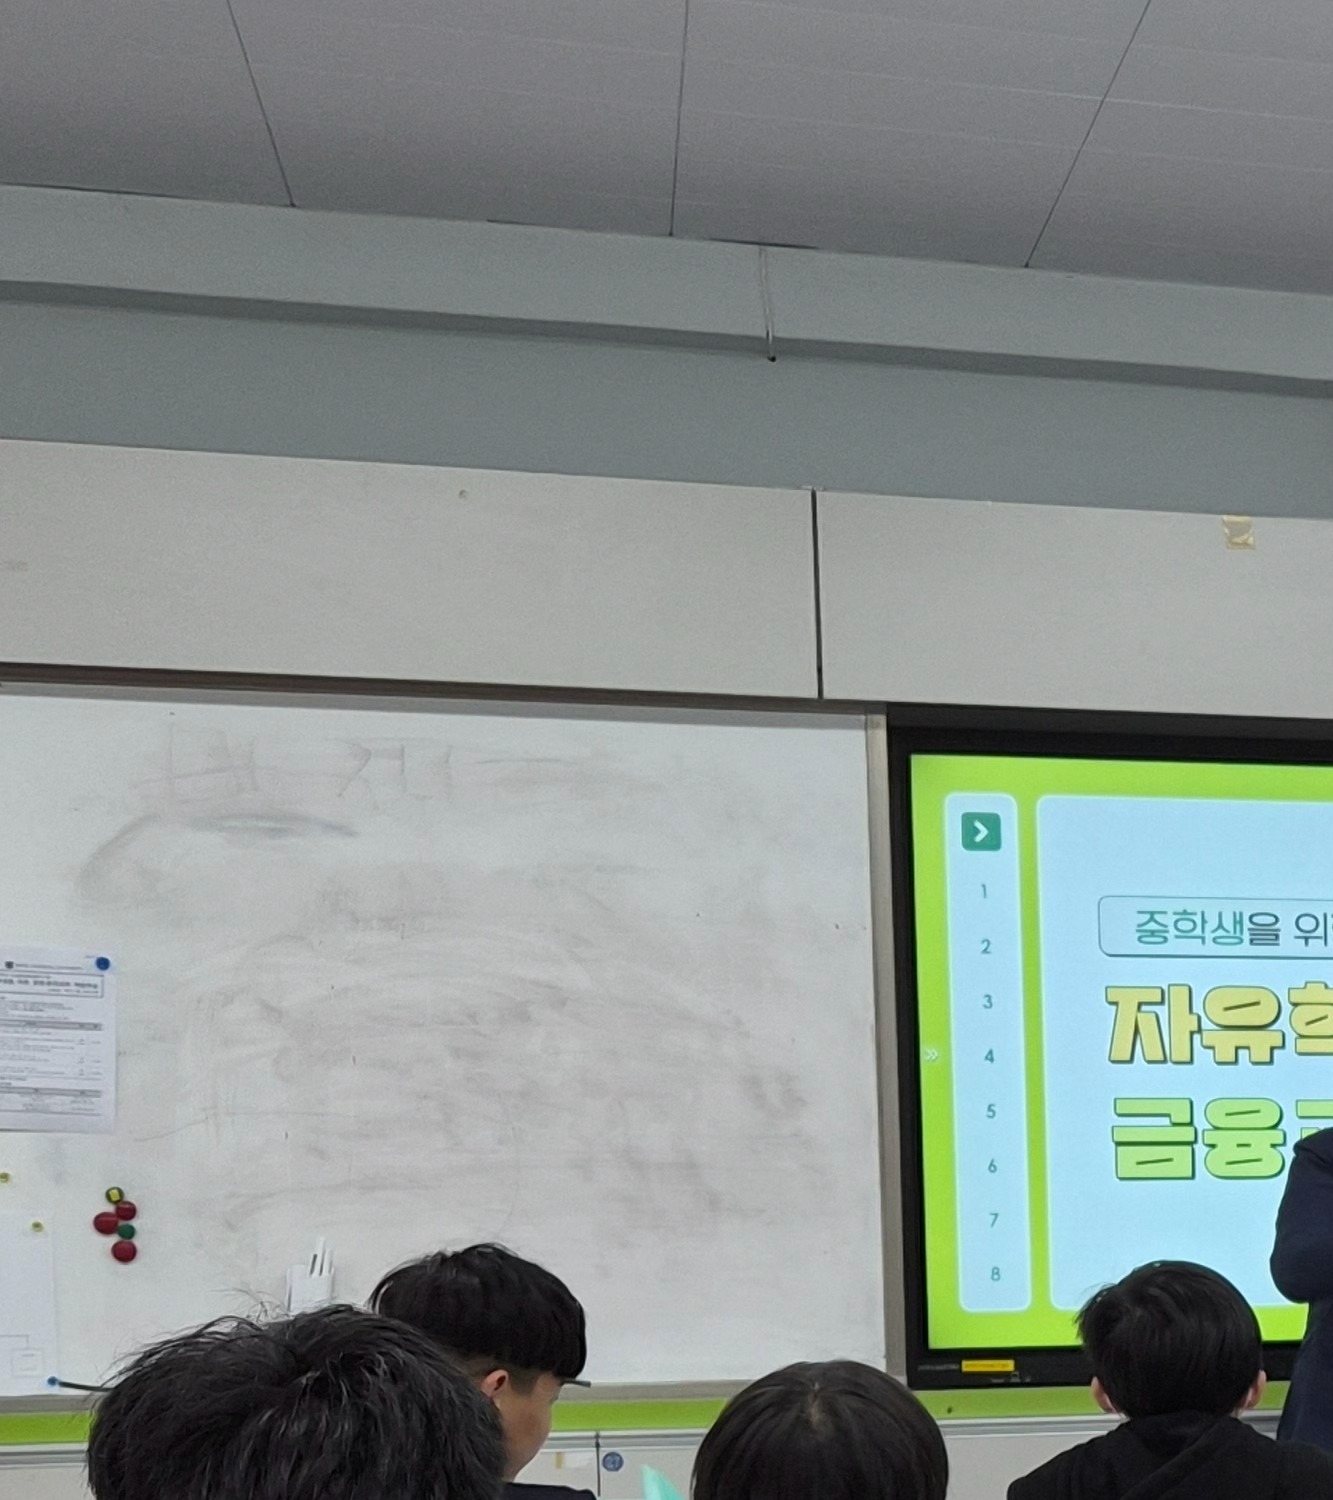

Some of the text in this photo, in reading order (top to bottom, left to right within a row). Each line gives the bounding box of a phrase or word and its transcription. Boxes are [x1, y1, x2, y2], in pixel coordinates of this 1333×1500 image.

[981, 883, 987, 899] 1
[1135, 908, 1281, 947] 중학생을
[980, 938, 992, 955] 2
[982, 993, 993, 1010] 3
[984, 1048, 995, 1065] 4
[986, 1103, 997, 1120] 5
[987, 1158, 998, 1175] 6
[989, 1212, 999, 1229] 7
[990, 1266, 1002, 1283] 8
